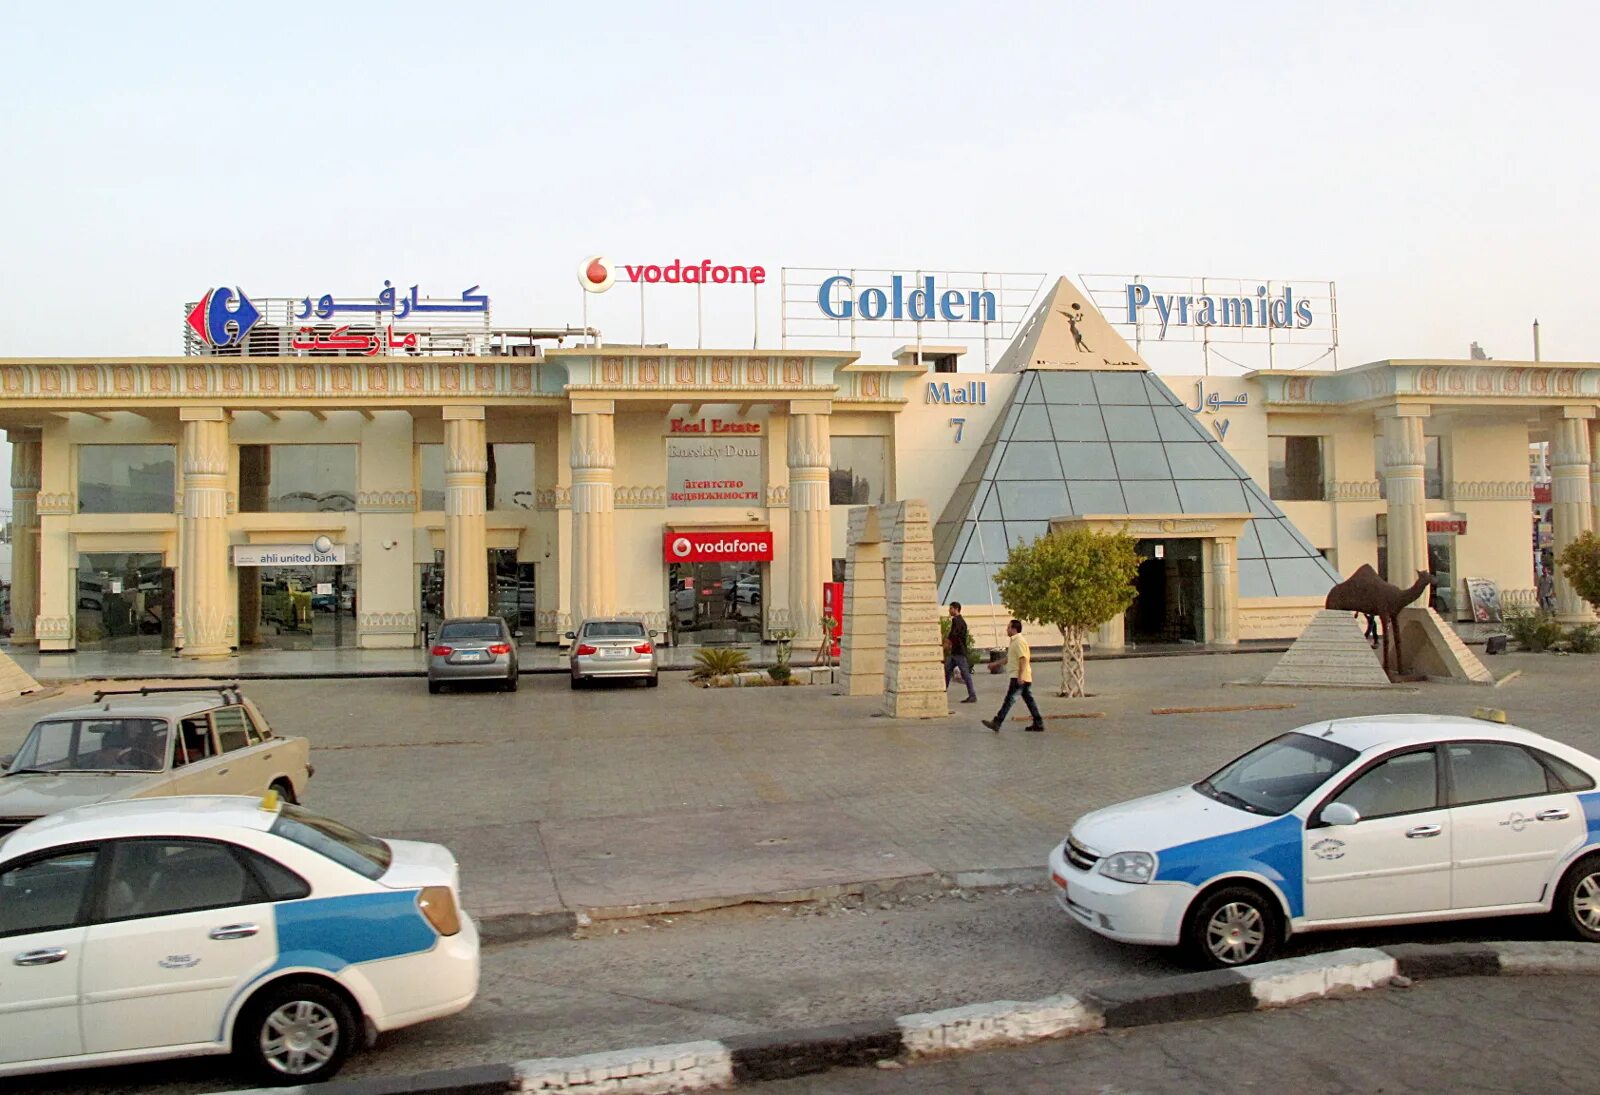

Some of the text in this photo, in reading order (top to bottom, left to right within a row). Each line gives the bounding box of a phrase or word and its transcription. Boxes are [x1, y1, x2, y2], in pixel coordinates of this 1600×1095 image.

[624, 259, 766, 284] vodafone
[295, 279, 489, 320] كارفور
[817, 275, 1314, 341] Golden Pyramids
[292, 324, 418, 357] ماركت
[926, 381, 987, 404] Mall
[1186, 376, 1249, 415] مول
[670, 417, 761, 433] Real Estate
[950, 417, 966, 443] 7
[725, 445, 760, 457] Dom
[260, 553, 278, 563] ahli
[280, 553, 312, 563] united
[313, 552, 338, 563] bank
[694, 539, 768, 553] vodafone
